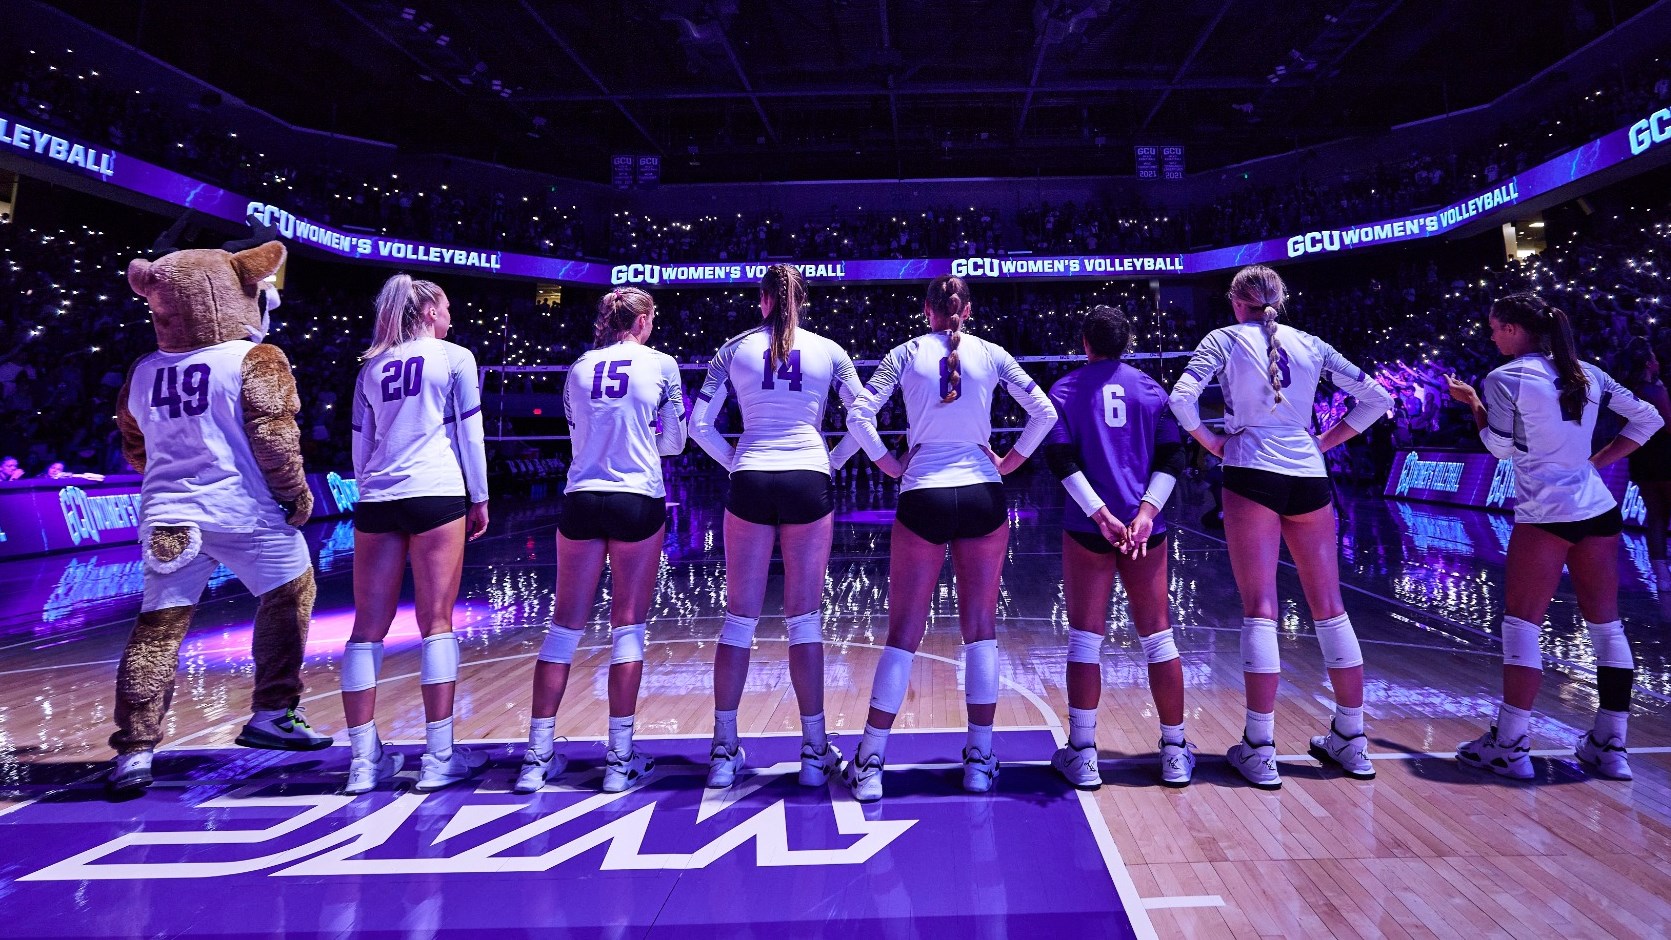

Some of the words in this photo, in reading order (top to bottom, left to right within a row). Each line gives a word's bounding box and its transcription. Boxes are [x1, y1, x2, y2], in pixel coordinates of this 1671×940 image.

[1628, 106, 1671, 155] GC
[1287, 230, 1340, 258] GCU
[1340, 216, 1439, 245] WOMEN'S
[1440, 182, 1519, 228] VOLLEYBALL
[295, 220, 372, 254] WOMEN'S
[378, 240, 501, 269] VOLLEYBALL
[951, 257, 1000, 279] GCU
[1001, 259, 1080, 273] WOMEN'S
[1084, 256, 1184, 273] VOLLEYBALL
[611, 263, 660, 285] GCU
[662, 265, 740, 280] WOMEN'S
[745, 264, 845, 278] VOYBALL
[151, 363, 211, 418] 49
[381, 356, 425, 403] 20
[590, 360, 632, 399] 15
[762, 349, 803, 391] 14
[1103, 384, 1127, 428] 6
[59, 486, 100, 545] GCU
